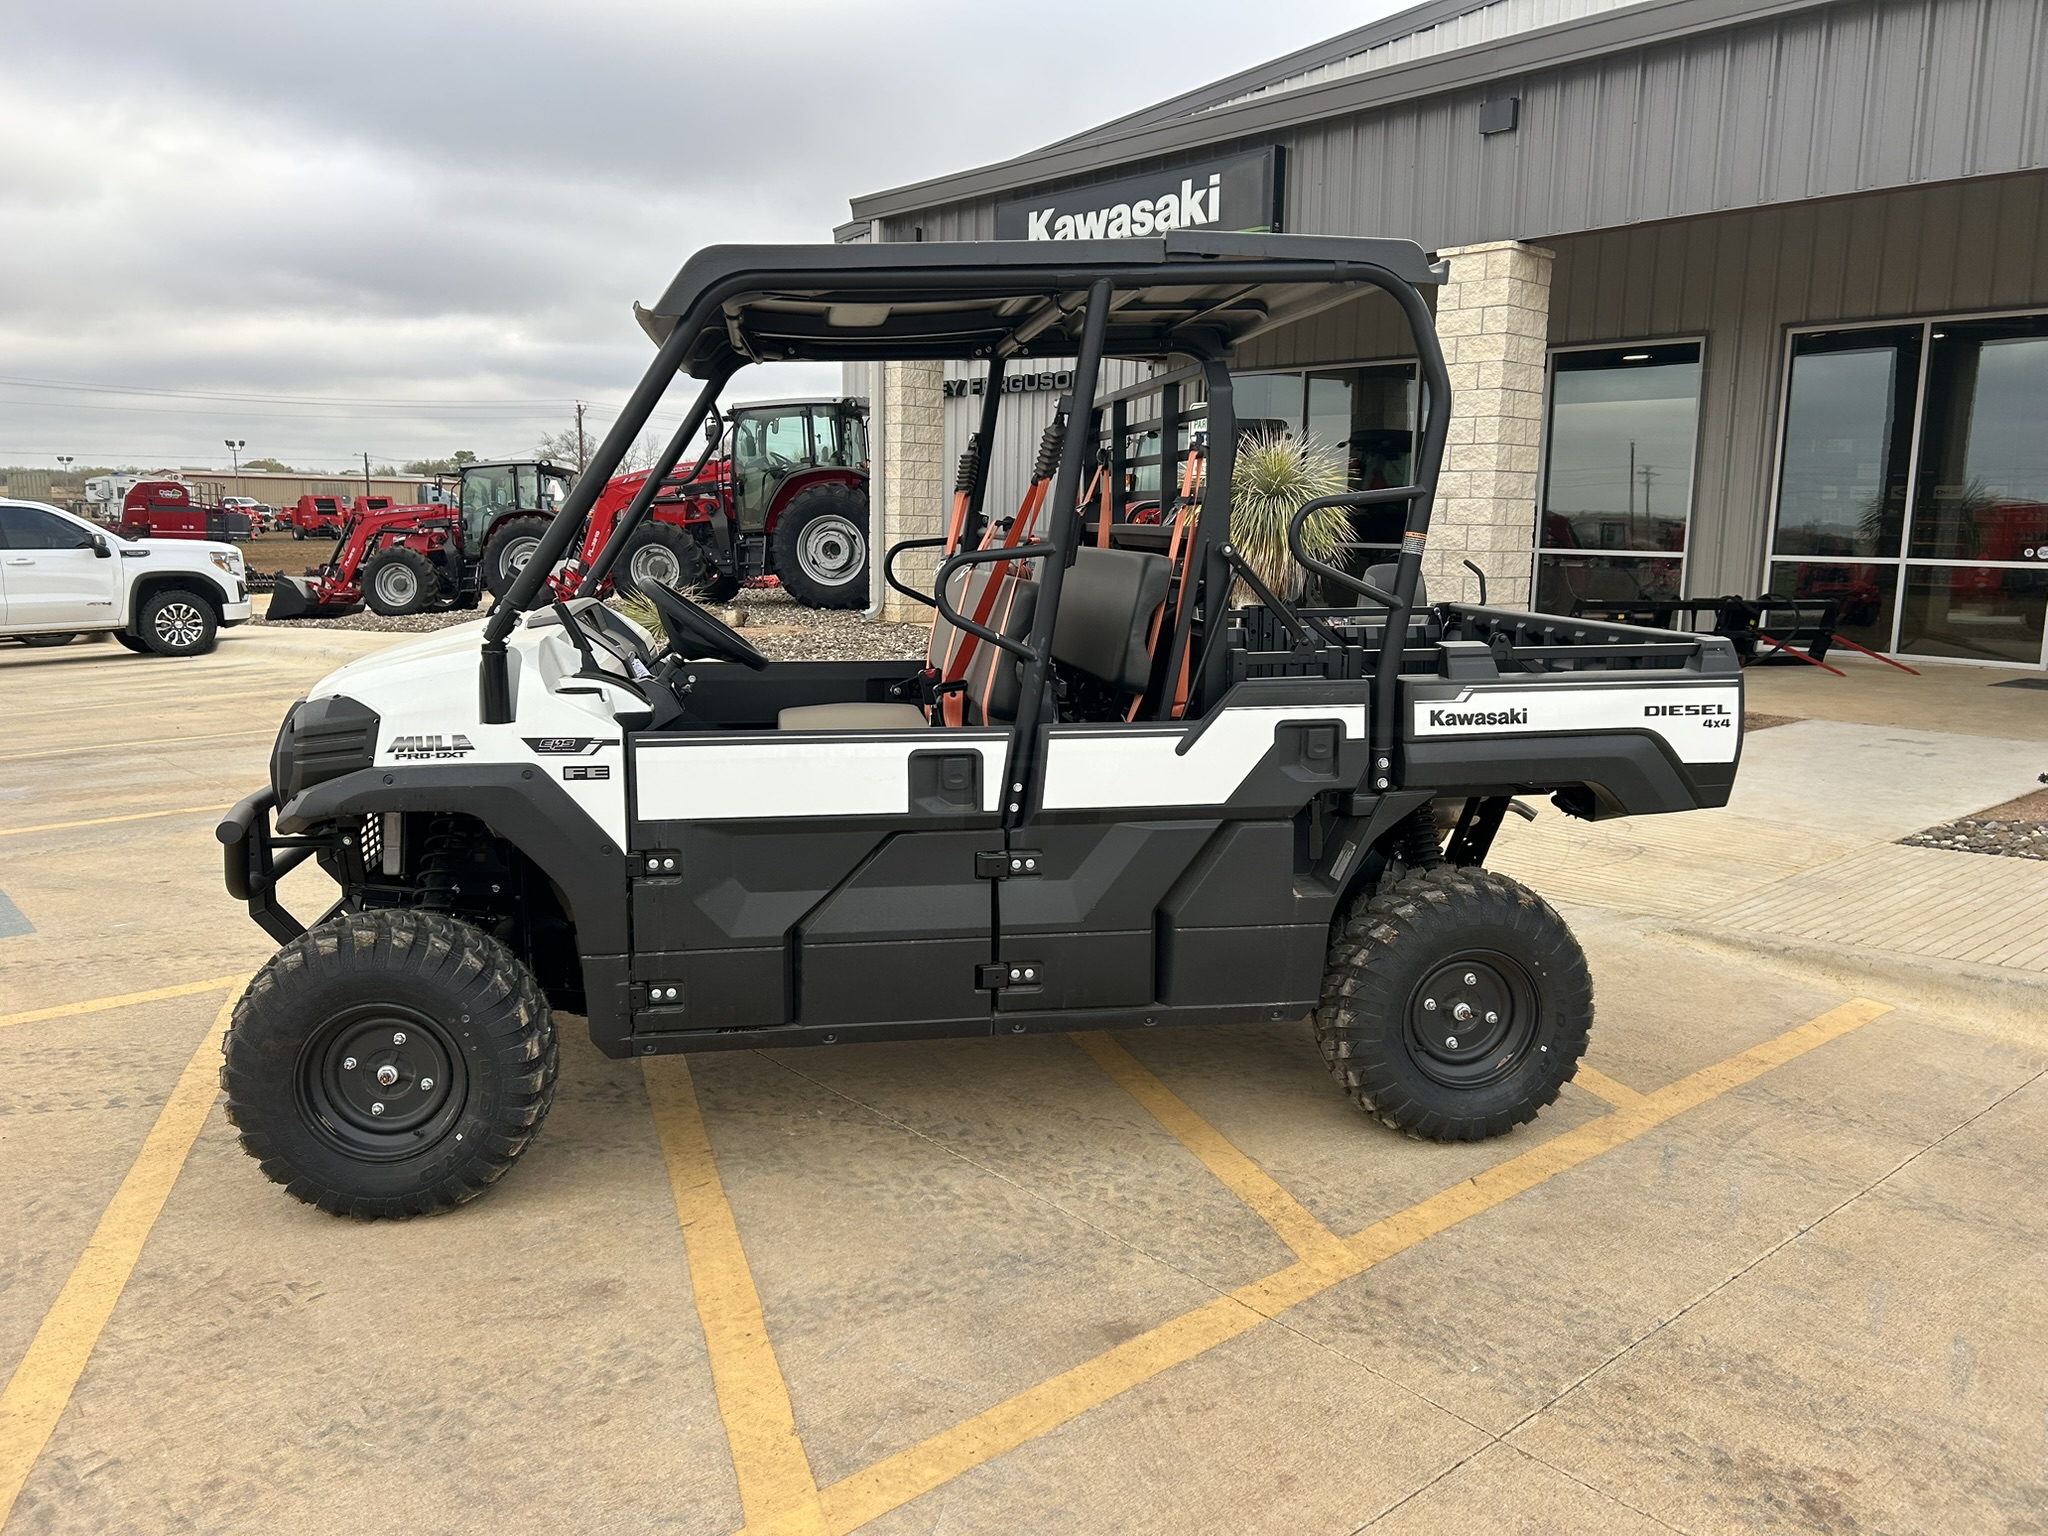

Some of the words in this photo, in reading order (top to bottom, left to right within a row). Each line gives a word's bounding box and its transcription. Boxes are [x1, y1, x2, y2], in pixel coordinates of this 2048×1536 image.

[1028, 173, 1221, 240] Kawasaki
[1430, 708, 1527, 726] Kawasaki
[1644, 704, 1731, 716] DIESEL
[1702, 718, 1731, 728] 4x4
[386, 735, 475, 753] MULE
[395, 751, 467, 760] PRO-DXT
[564, 766, 609, 780] FE
